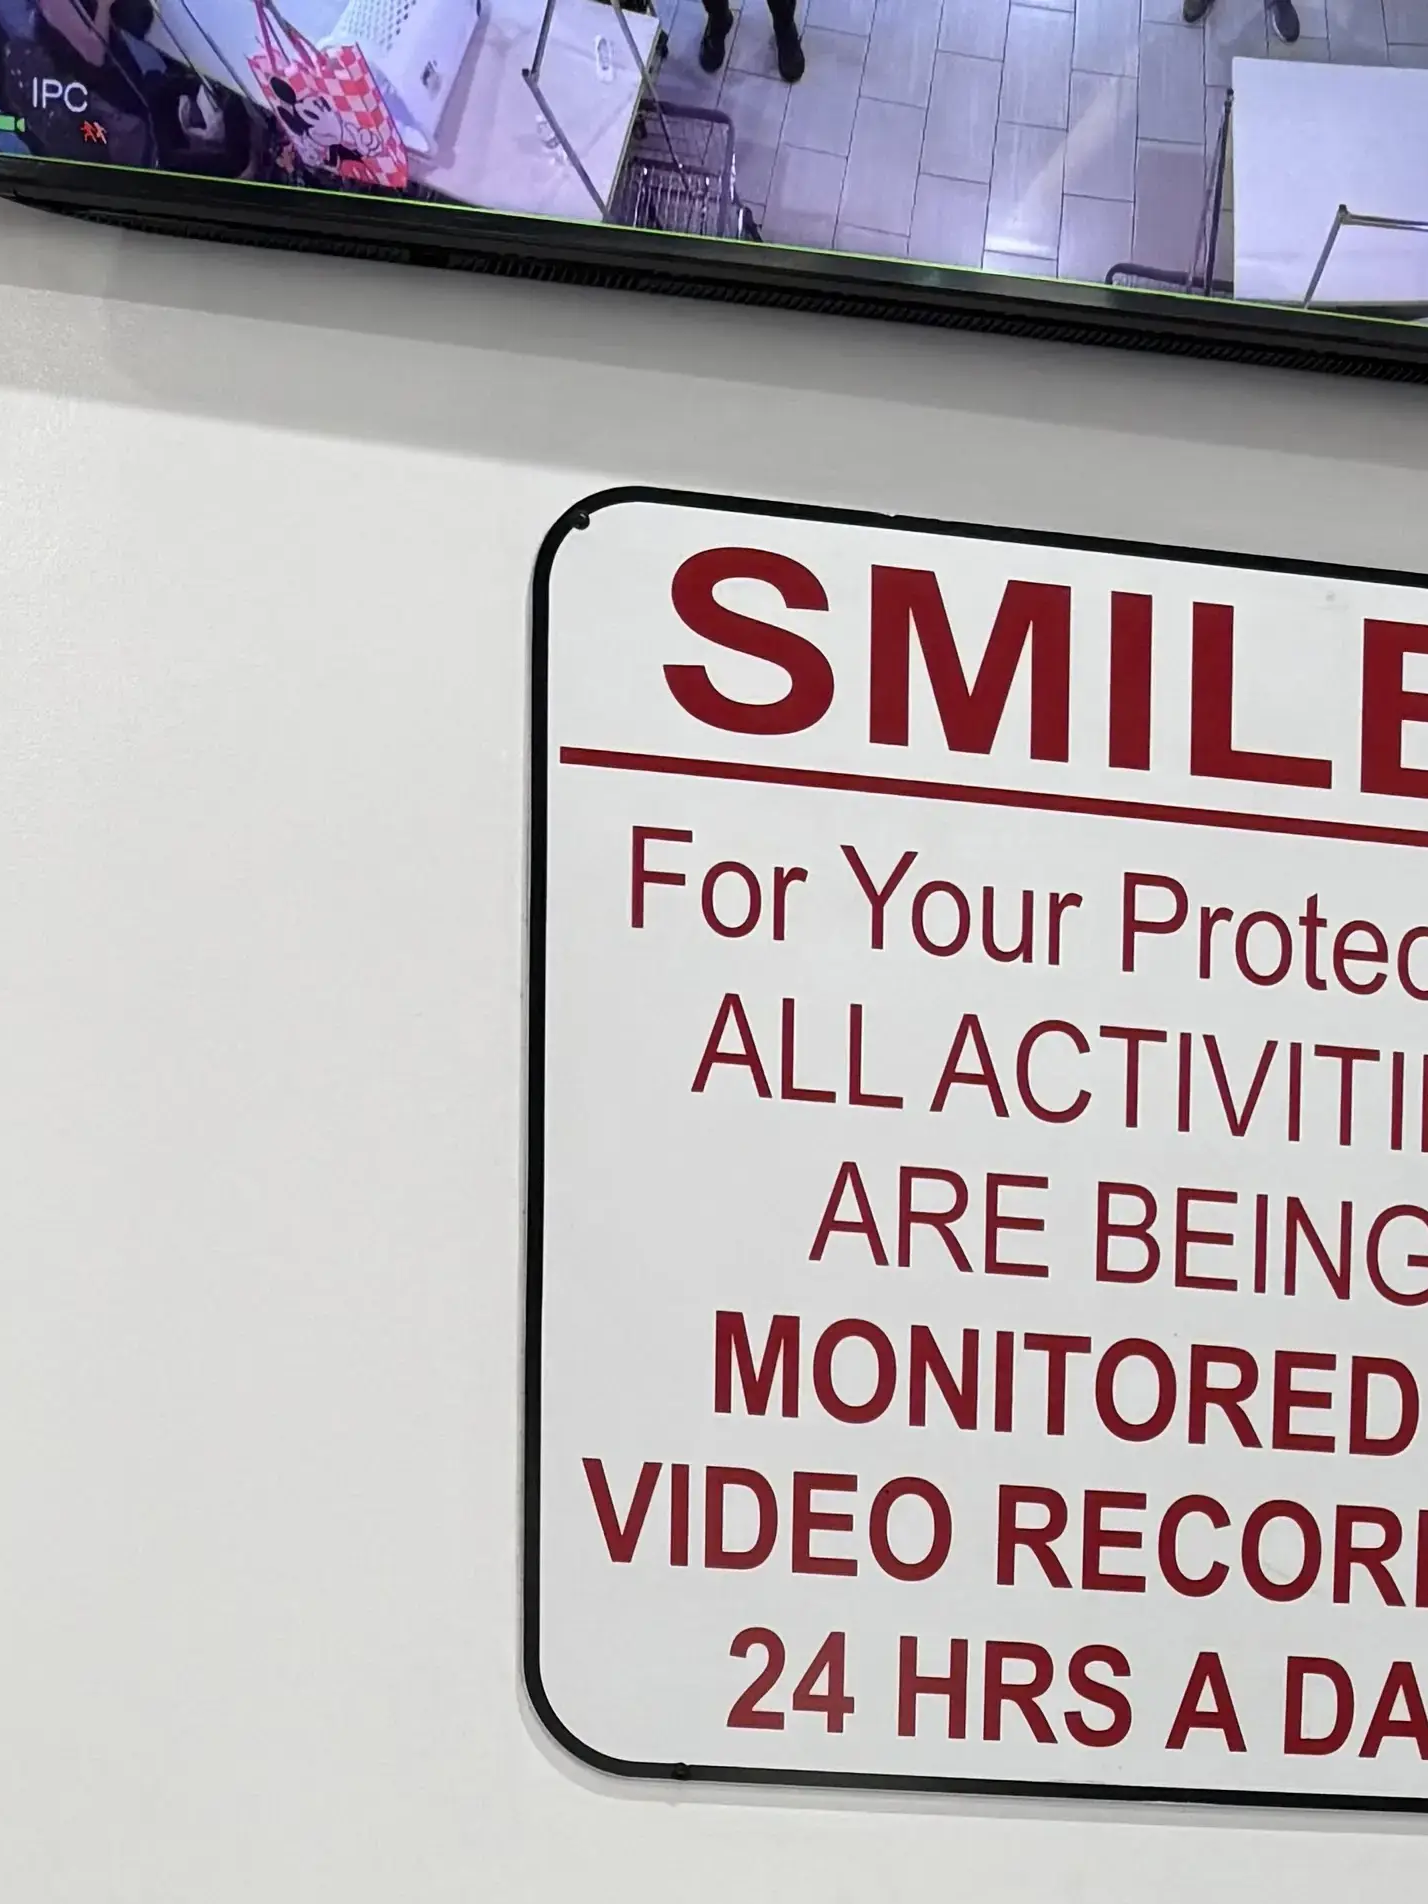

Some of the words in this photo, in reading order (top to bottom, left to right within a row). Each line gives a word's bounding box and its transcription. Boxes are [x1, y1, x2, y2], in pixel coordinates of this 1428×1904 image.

[32, 77, 88, 112] IPC
[632, 828, 806, 940] For
[844, 847, 1081, 963] Your
[692, 994, 900, 1107] ALL
[810, 1162, 1047, 1276] ARE
[714, 1312, 1418, 1456] MONITORED
[584, 1460, 951, 1581] VIDEO
[728, 1628, 853, 1731] 24
[898, 1638, 1131, 1747] HRS
[1167, 1653, 1244, 1753] A
